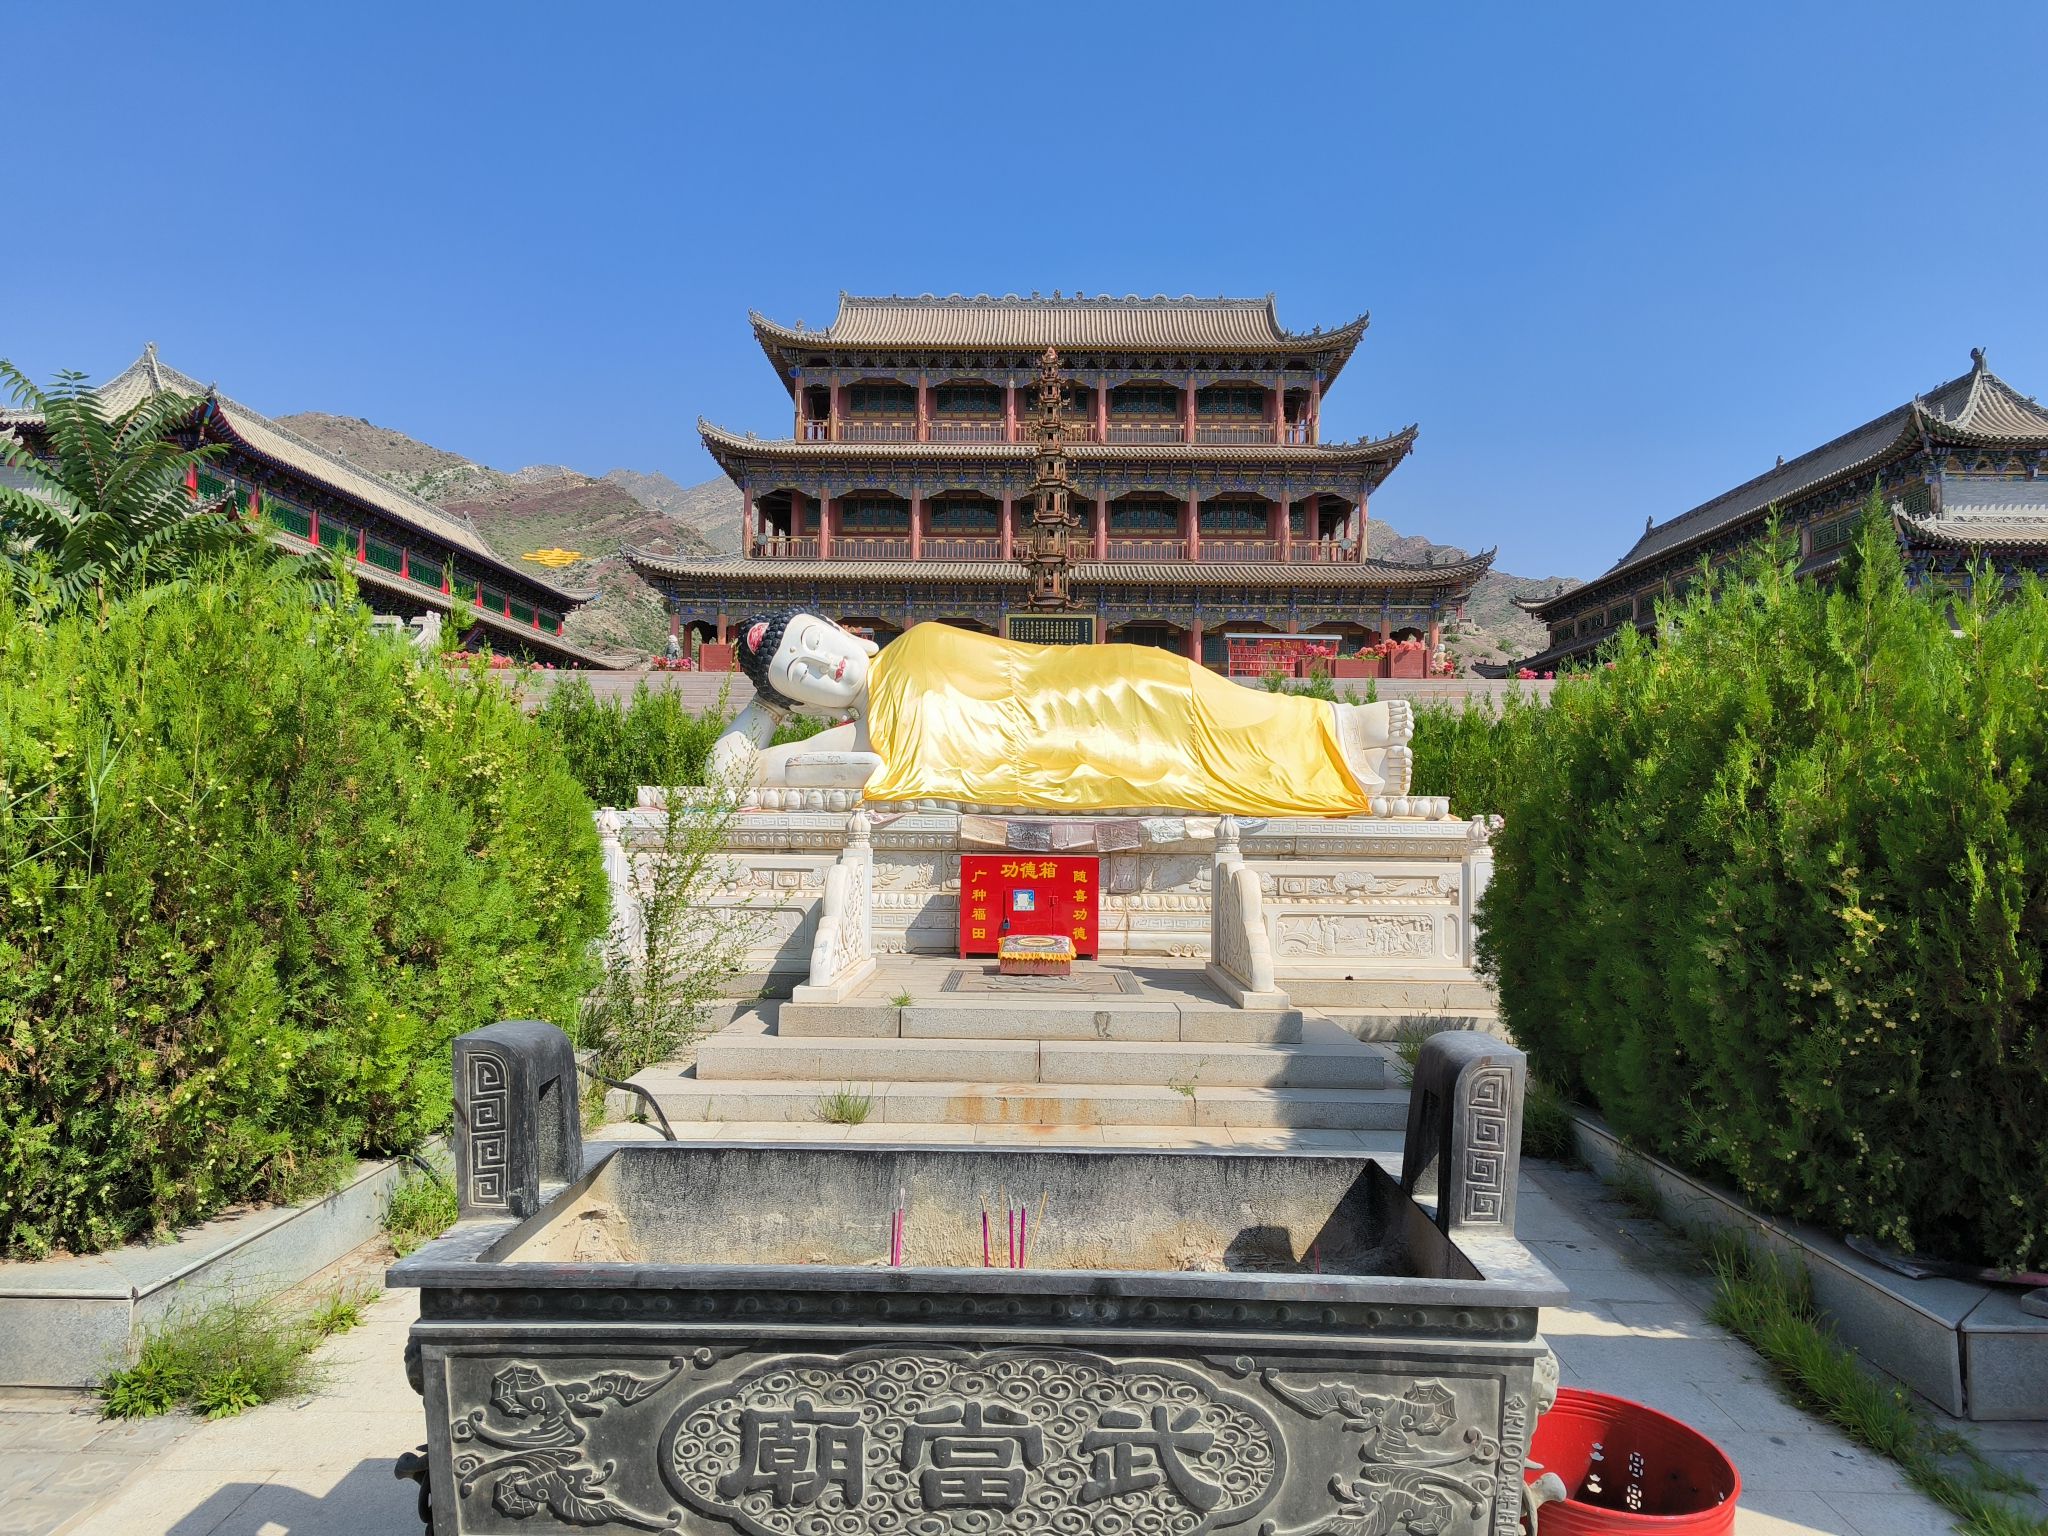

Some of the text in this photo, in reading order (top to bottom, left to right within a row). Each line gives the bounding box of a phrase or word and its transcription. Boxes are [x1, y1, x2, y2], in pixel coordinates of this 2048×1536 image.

[971, 870, 987, 939] 广种福田
[1000, 861, 1058, 879] 功德箱
[1073, 870, 1088, 941] 随喜功德
